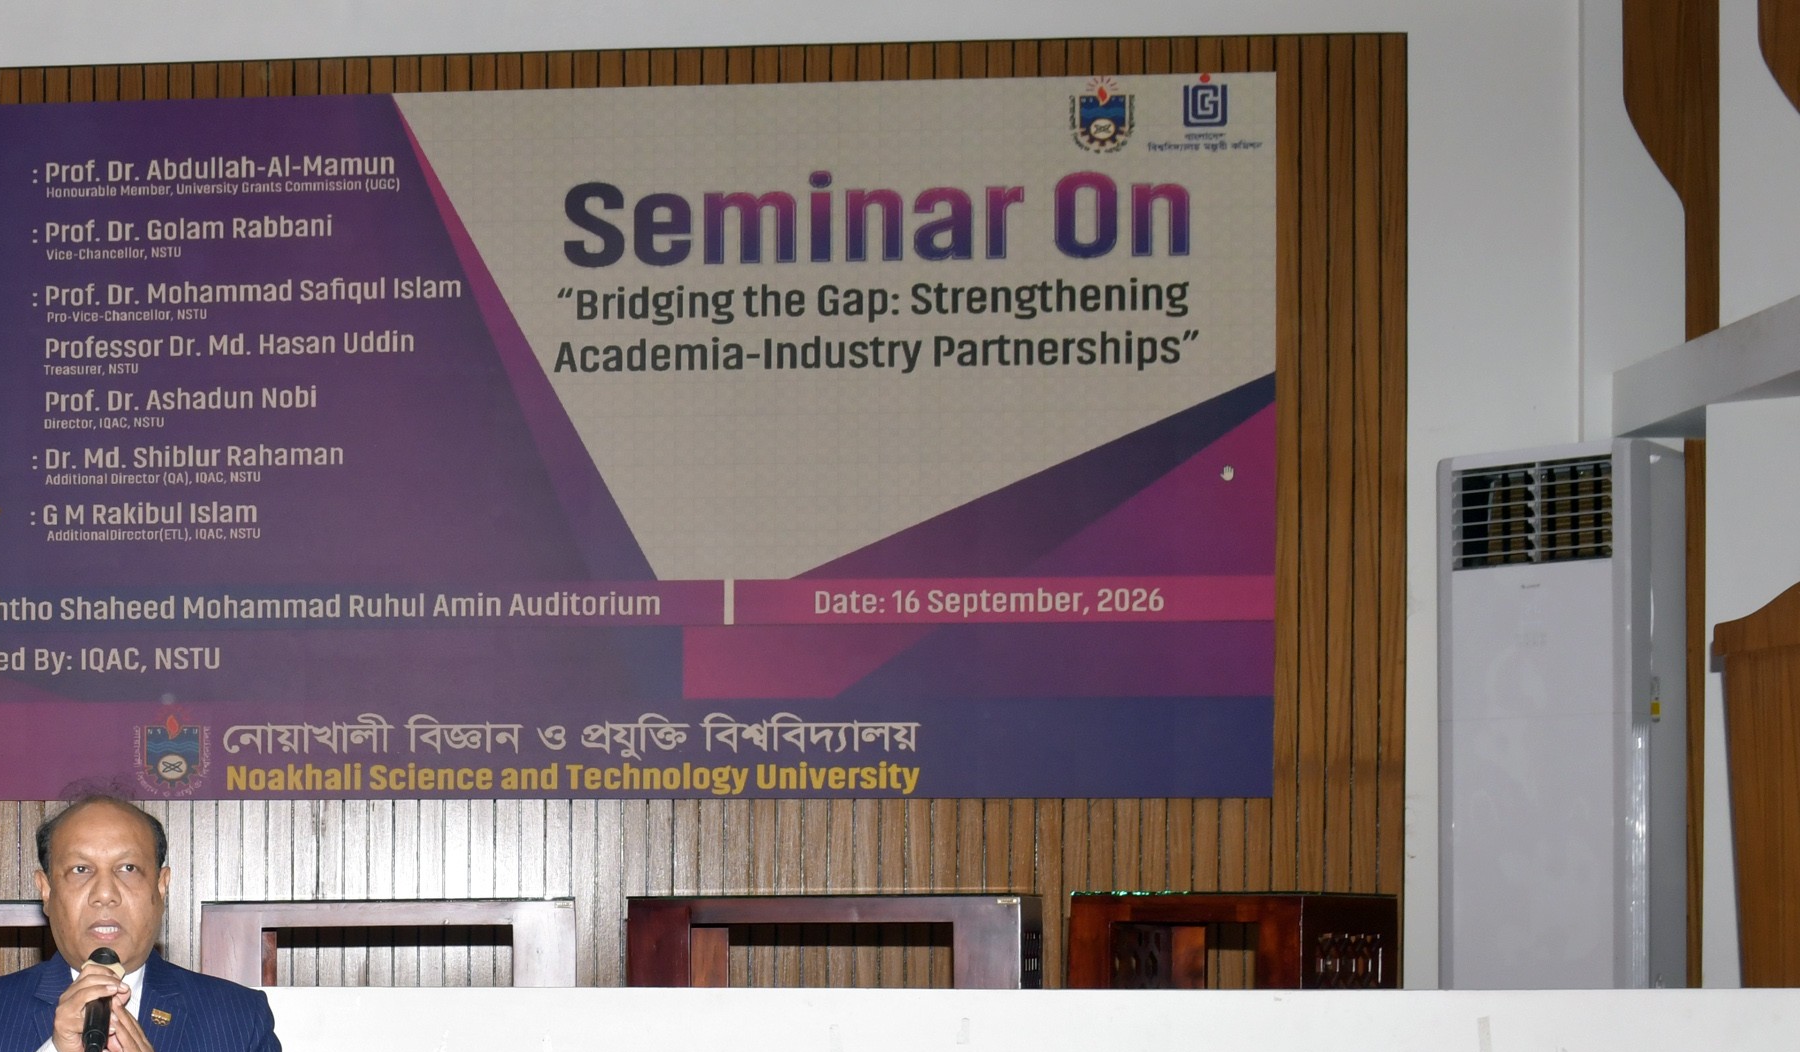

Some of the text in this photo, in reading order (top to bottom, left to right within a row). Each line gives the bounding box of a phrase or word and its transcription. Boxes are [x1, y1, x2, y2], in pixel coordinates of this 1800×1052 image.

[45, 159, 100, 184] Prof.
[108, 160, 140, 182] Dr.
[146, 155, 396, 182] Abdullah-Al-Mamun
[46, 177, 401, 199] Honourable Member, University Grants Commission (UGC)
[45, 219, 101, 243] Prof.
[107, 220, 140, 242] Dr.
[147, 217, 224, 241] Golam
[232, 213, 333, 239] Rabbani
[563, 170, 1191, 269] Seminar On
[46, 246, 182, 261] Vice-Chancellor, NSTU
[45, 283, 100, 307] Prof.
[107, 284, 140, 305] Dr.
[147, 279, 292, 305] Mohammad
[300, 276, 386, 305] Safiqul
[393, 276, 461, 300] Islam
[742, 283, 805, 318] the
[817, 284, 900, 323] Gap:
[911, 277, 1190, 320] Strengthening
[46, 308, 207, 323] Pro-Vice-Chancellor, NSTU
[45, 329, 414, 359] Professor Dr. Md. Hasan Uddin
[553, 335, 923, 374] Academia-Industry
[43, 362, 139, 376] Treasurer, NSTU
[45, 384, 317, 413] Prof. Dr. Ashadun Nobi
[43, 416, 165, 431] Director, IQAC, NSTU
[45, 448, 77, 470] Dr.
[84, 446, 127, 469] Md.
[133, 446, 221, 469] Shiblur
[226, 444, 345, 467] Rahaman
[45, 471, 261, 486] Additional Director (QA), IQAC, NSTU
[43, 504, 58, 526] G
[65, 504, 84, 525] M
[92, 501, 182, 526] Rakibul
[190, 501, 258, 524] Islam
[47, 527, 261, 543] AdditionalDirector(ETL), IQAC, NSTU
[60, 595, 175, 621] Shaheed
[183, 593, 341, 620] Mohammad
[349, 592, 425, 618] Ruhul
[432, 592, 502, 617] Amin
[508, 591, 661, 617] Auditorium
[814, 587, 1165, 618] Date: 16 September, 2026
[34, 648, 73, 676] By:
[81, 647, 147, 674] IQAC,
[155, 646, 220, 670] NSTU
[222, 712, 920, 761] নোয়াখালী বিজ্ঞান ও প্রযুক্তি বিশ্ববিদ্যালয়
[227, 761, 920, 795] Noakhali Science and Technology University
